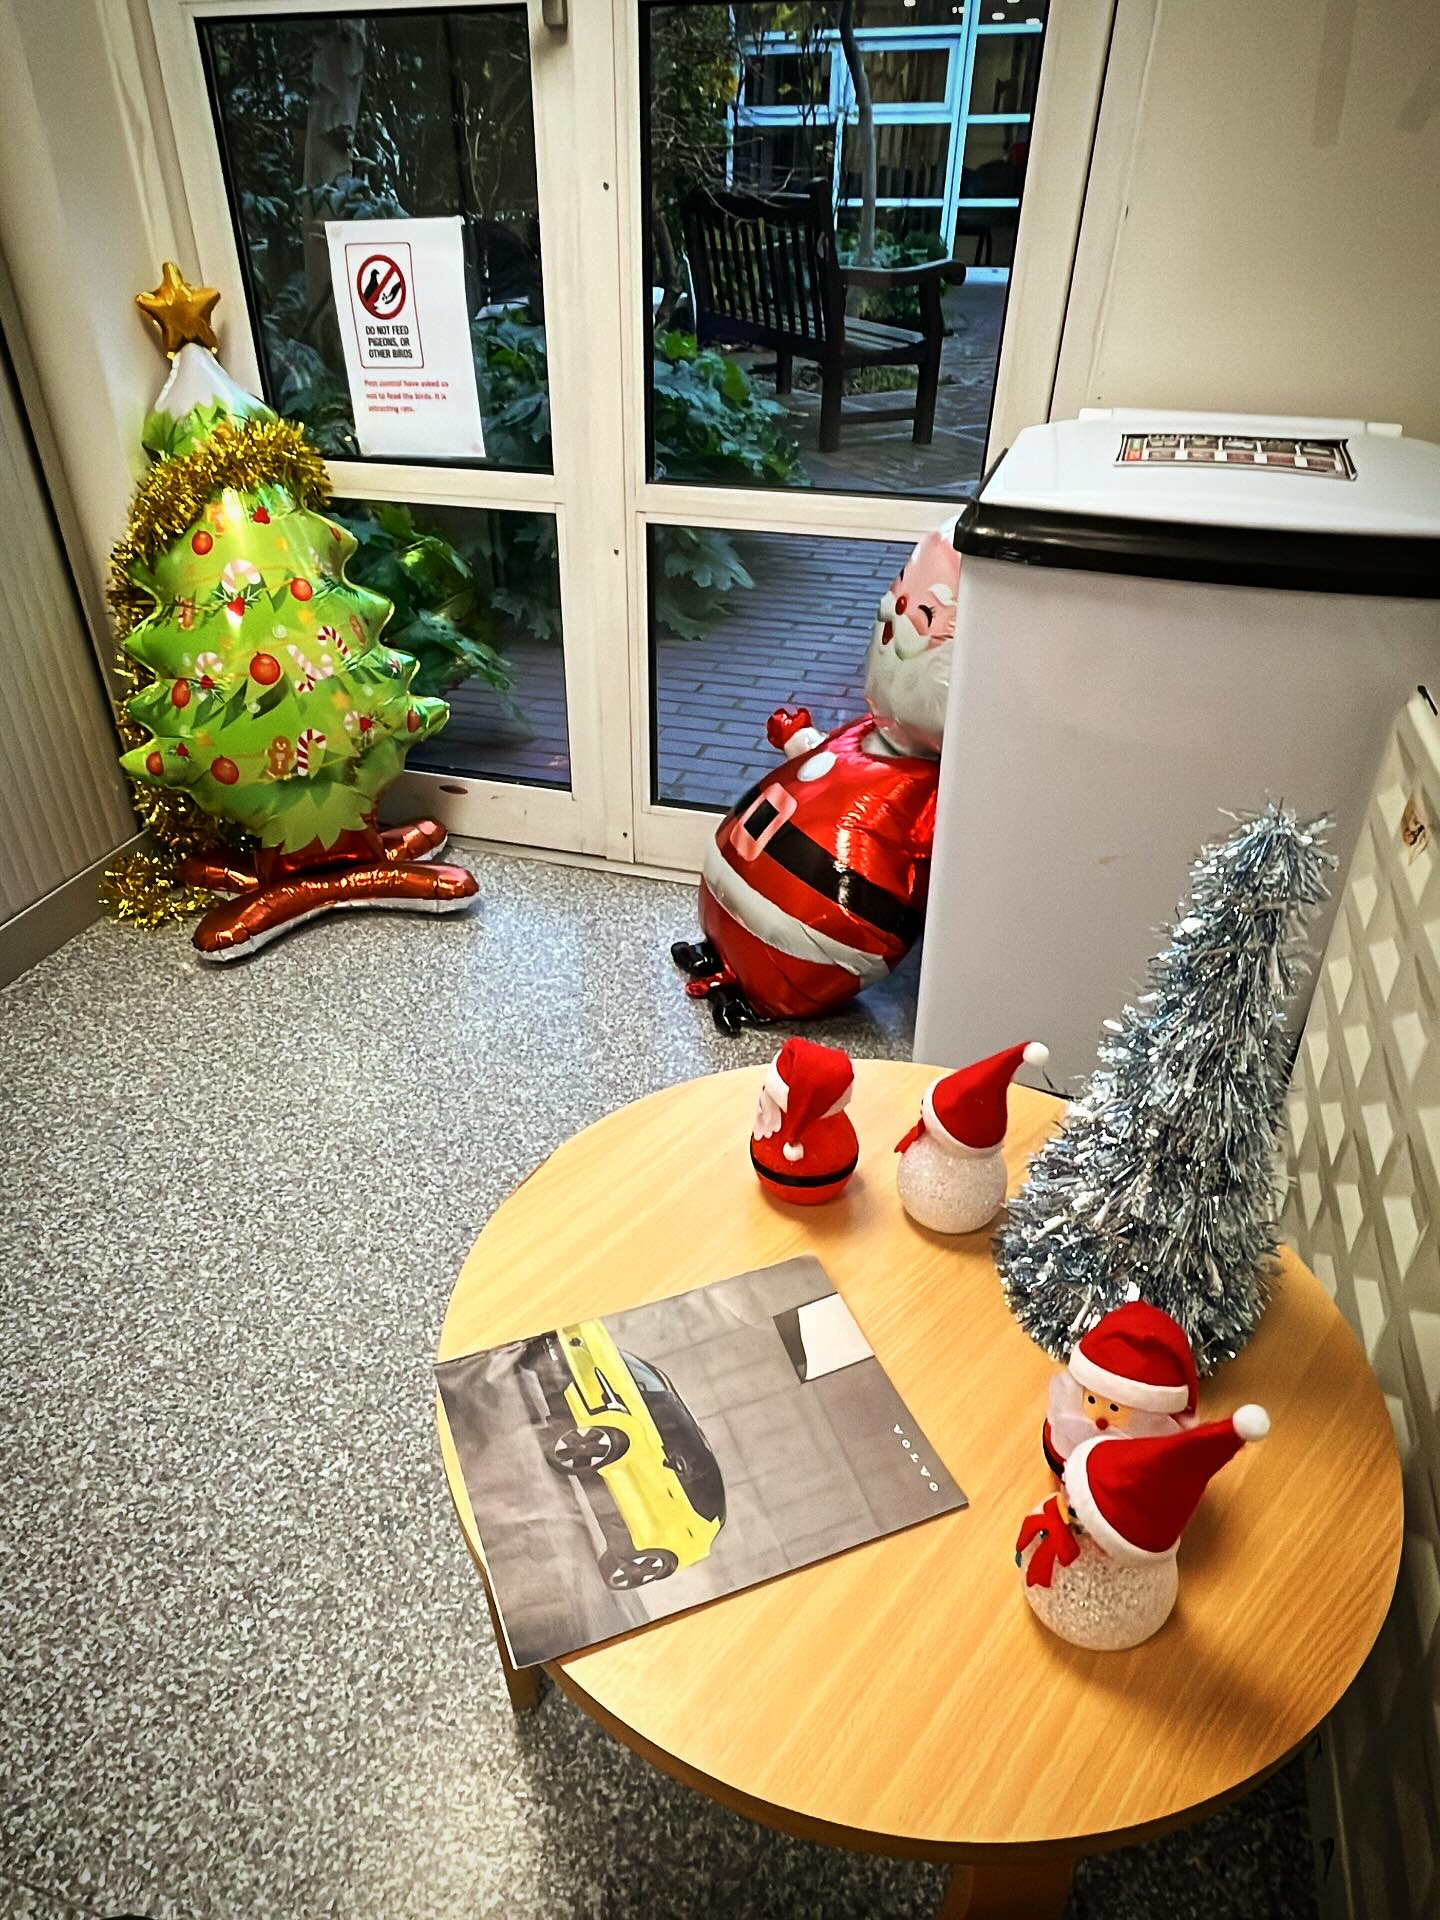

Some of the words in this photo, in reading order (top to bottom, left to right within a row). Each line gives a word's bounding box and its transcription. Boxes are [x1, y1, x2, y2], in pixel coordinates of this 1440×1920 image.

[365, 325, 376, 335] DO
[376, 325, 390, 335] NOT
[391, 325, 409, 335] FEED
[367, 337, 399, 347] PIGEONS,
[400, 337, 410, 346] OR
[368, 349, 391, 358] OTHER
[392, 349, 413, 358] BIRDS
[893, 1423, 939, 1492] VOLVO
